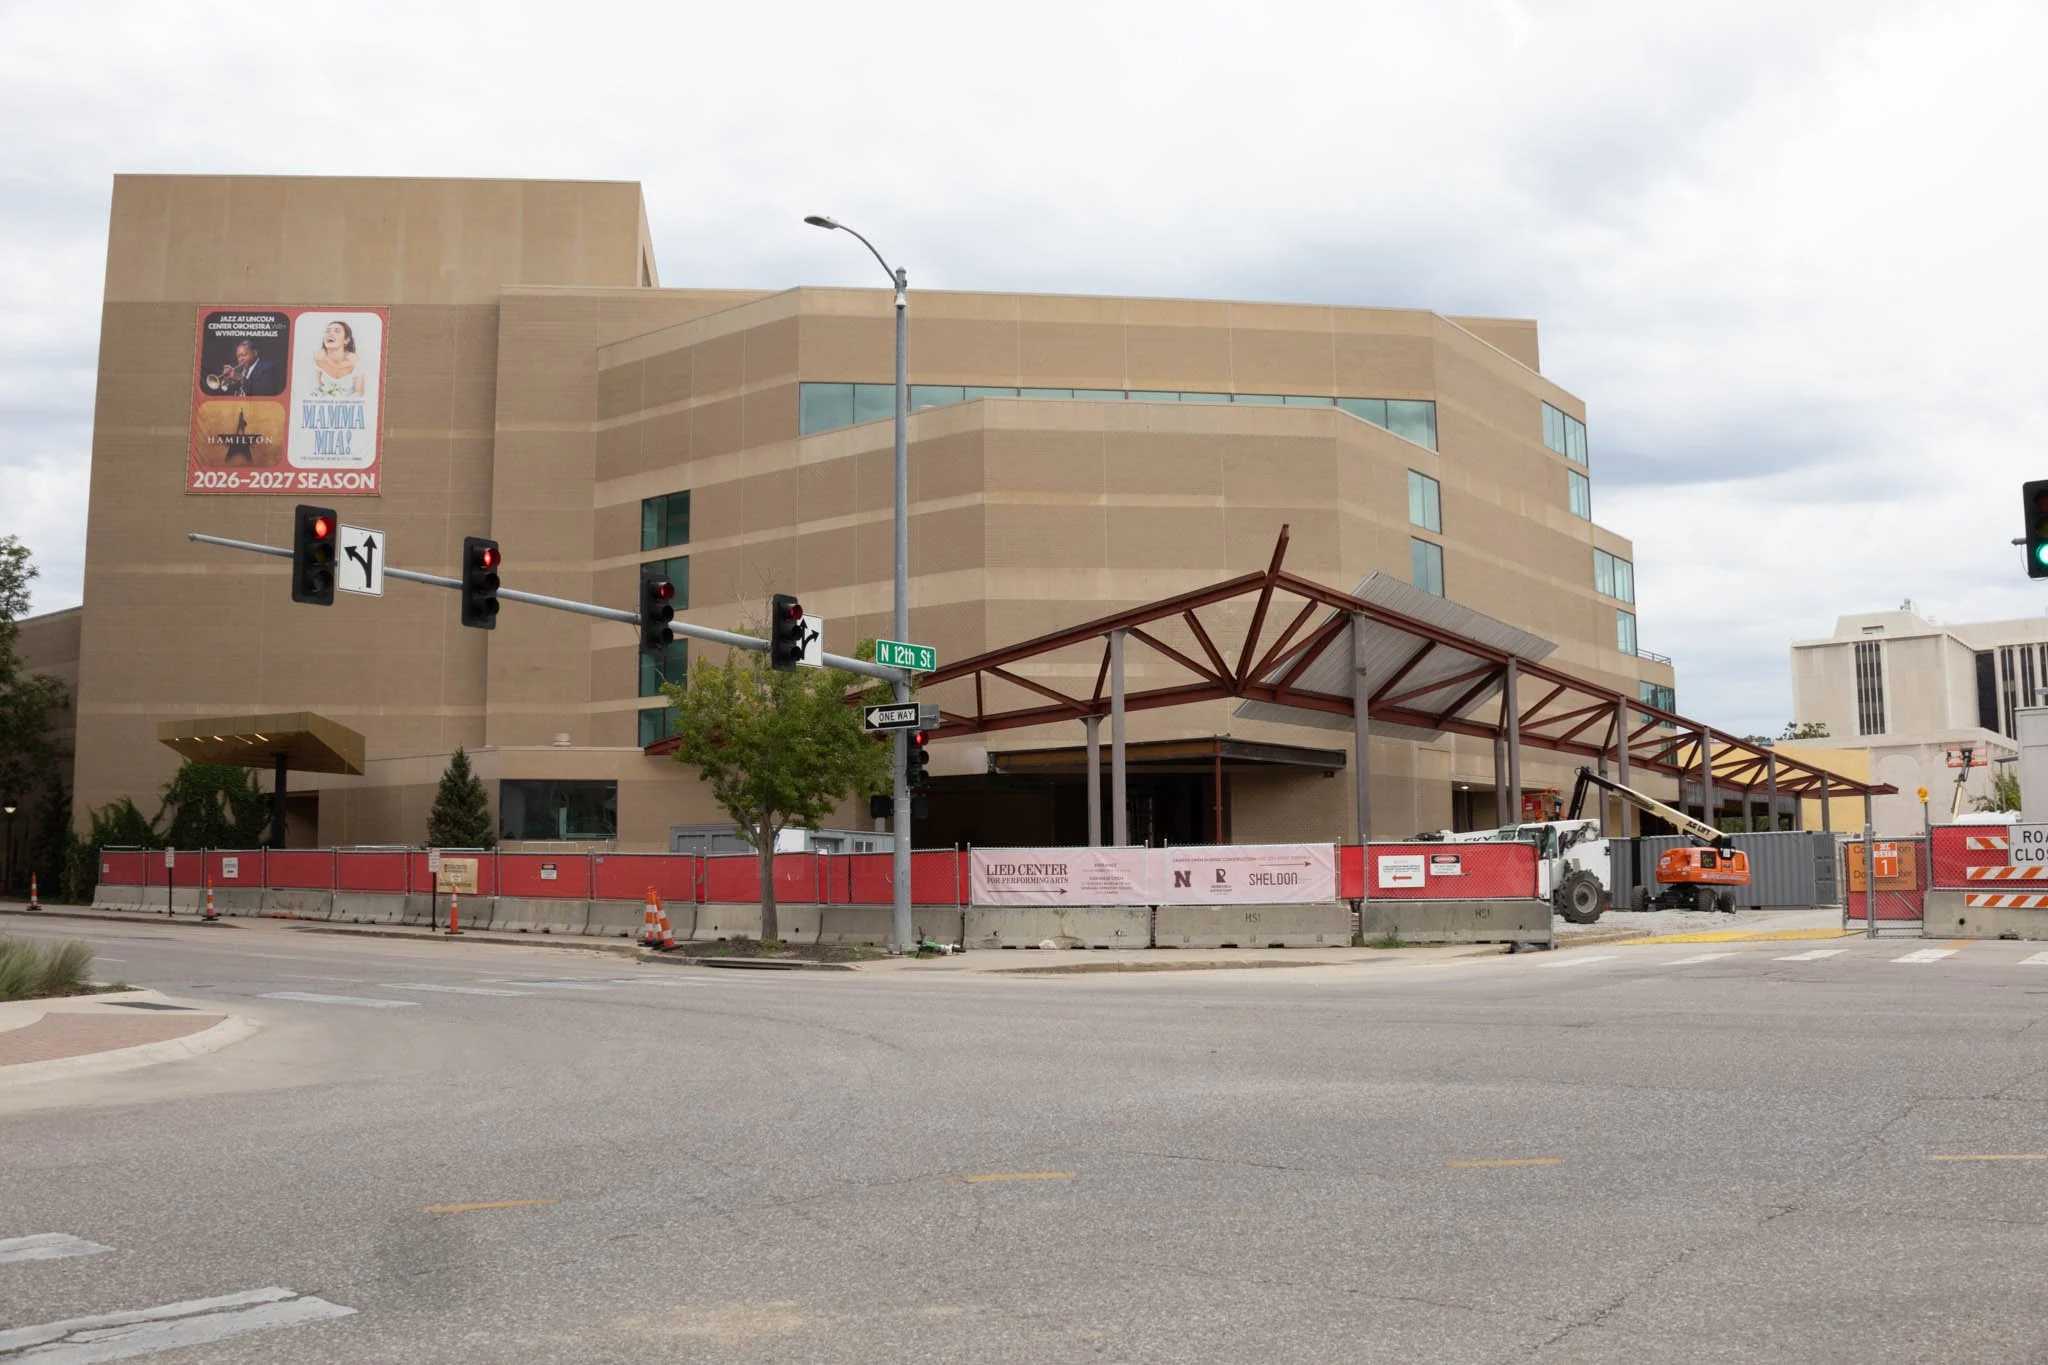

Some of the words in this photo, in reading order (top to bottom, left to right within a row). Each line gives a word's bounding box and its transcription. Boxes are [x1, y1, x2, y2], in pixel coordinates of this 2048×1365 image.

[301, 405, 365, 429] MAMMA
[207, 435, 273, 445] HAMILTON
[314, 430, 352, 455] MIA!
[297, 472, 376, 489] SEASON
[881, 643, 889, 662] N
[894, 645, 915, 666] 12th
[920, 649, 931, 668] St
[879, 711, 895, 722] ONE
[897, 710, 914, 720] WAY
[985, 864, 1016, 876] LIED
[1017, 863, 1068, 876] CENTER
[1880, 859, 1888, 875] 1
[986, 877, 1001, 885] FOR
[1001, 877, 1049, 885] PERFORMING
[1174, 870, 1192, 888] N
[1248, 872, 1298, 886] SHELDON
